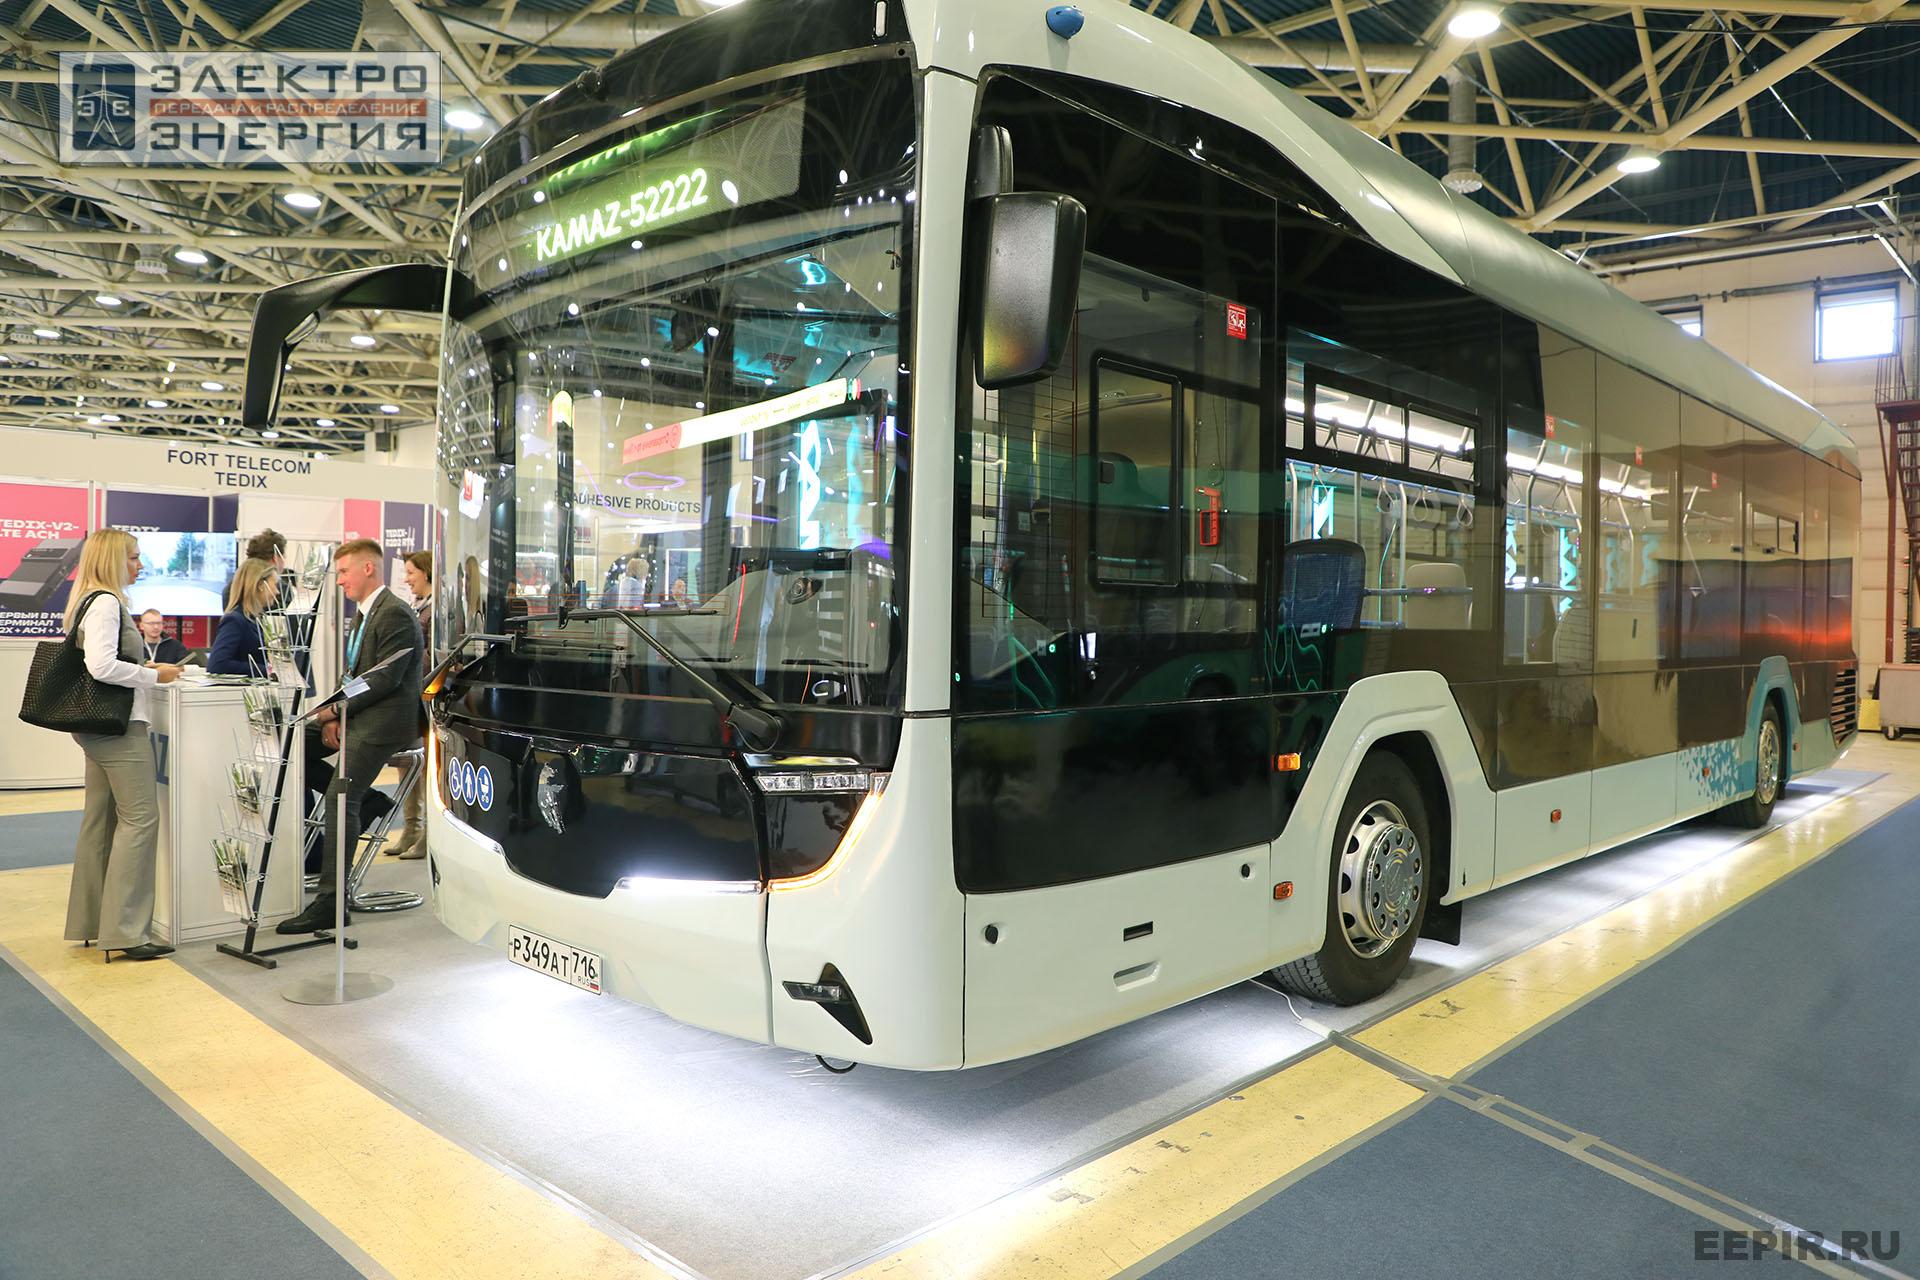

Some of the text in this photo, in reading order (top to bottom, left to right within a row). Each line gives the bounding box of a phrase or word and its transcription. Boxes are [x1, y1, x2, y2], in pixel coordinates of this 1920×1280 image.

[537, 168, 708, 261] KAMAZ-52222
[168, 449, 311, 475] FORT TELECOM
[214, 471, 268, 489] TEDIX
[635, 497, 701, 514] PRODUCTS
[572, 951, 597, 979] 716
[577, 975, 590, 986] RUS
